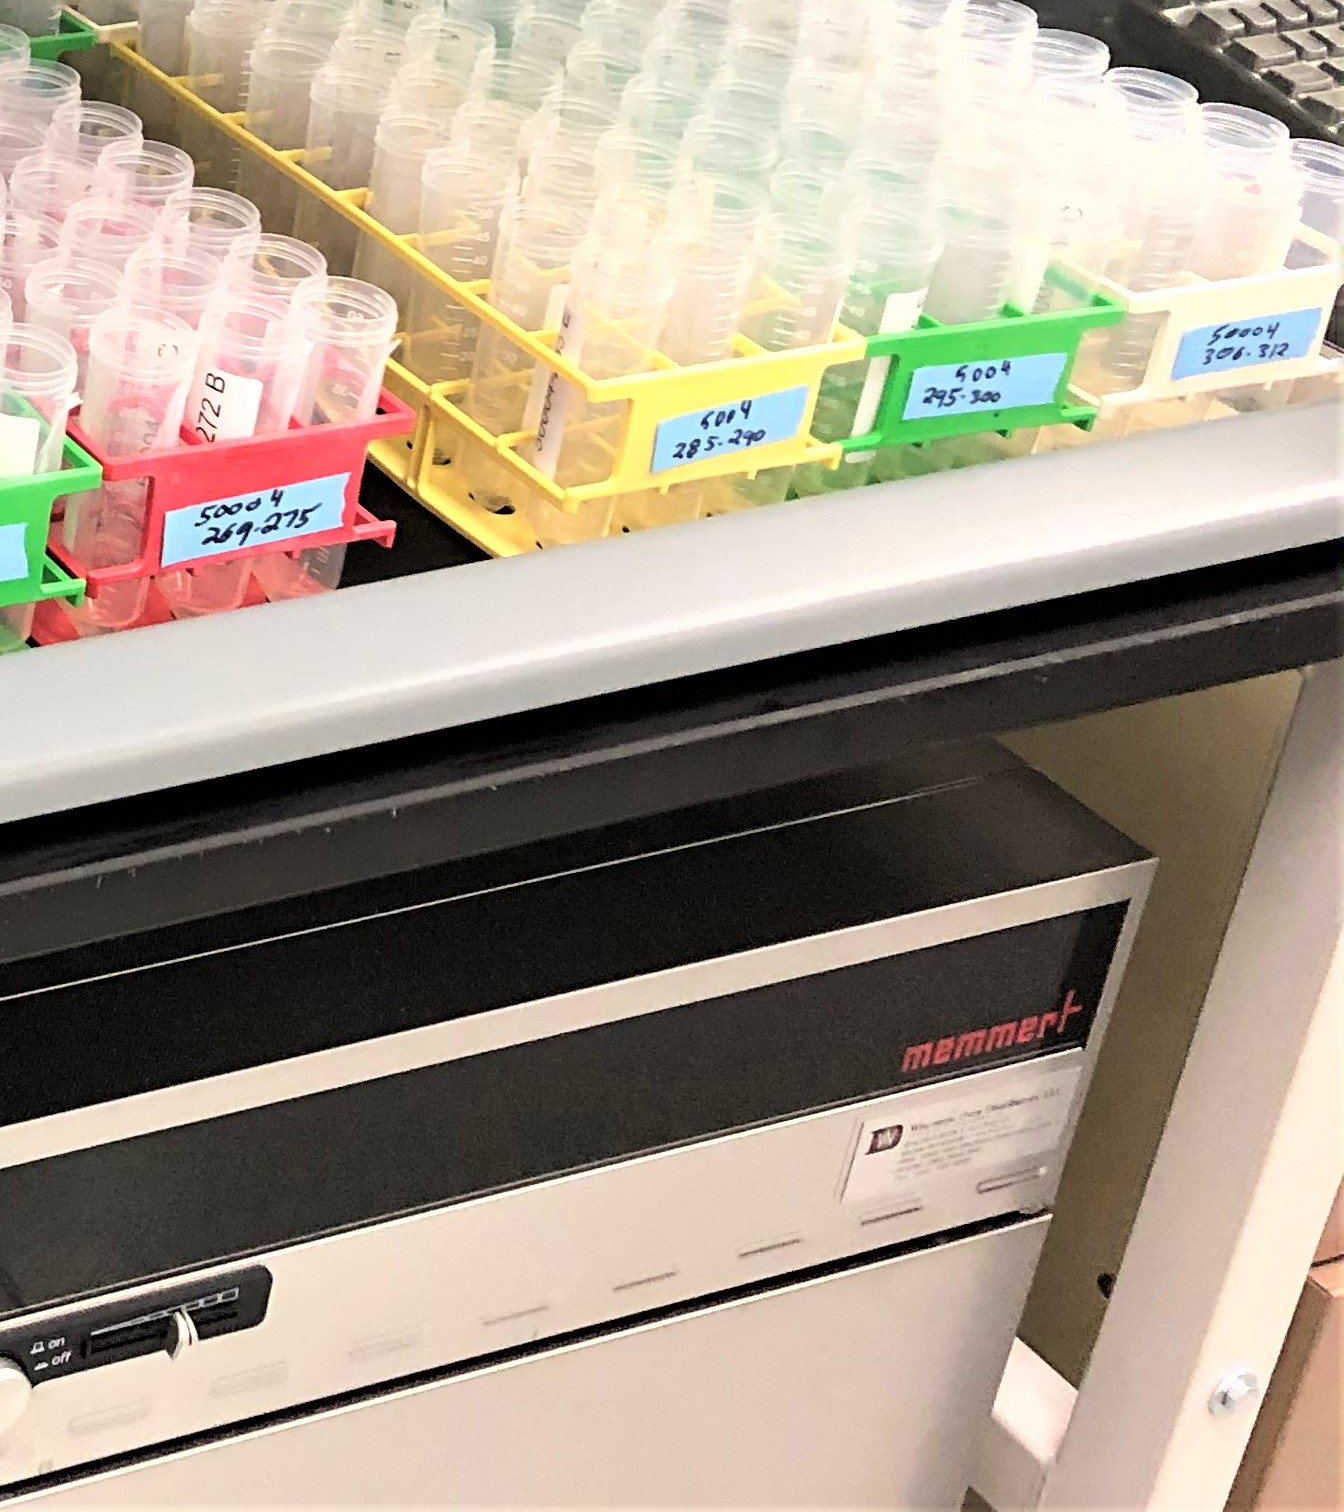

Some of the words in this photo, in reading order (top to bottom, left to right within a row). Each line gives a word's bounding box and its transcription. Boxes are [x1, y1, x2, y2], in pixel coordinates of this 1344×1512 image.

[1207, 322, 1280, 346] 50004
[956, 360, 1011, 382] 5004
[205, 372, 226, 394] B
[196, 398, 221, 443] 272
[195, 489, 284, 527] 50004
[900, 989, 1083, 1073] memmert
[48, 1337, 65, 1349] on
[52, 1351, 72, 1366] off
